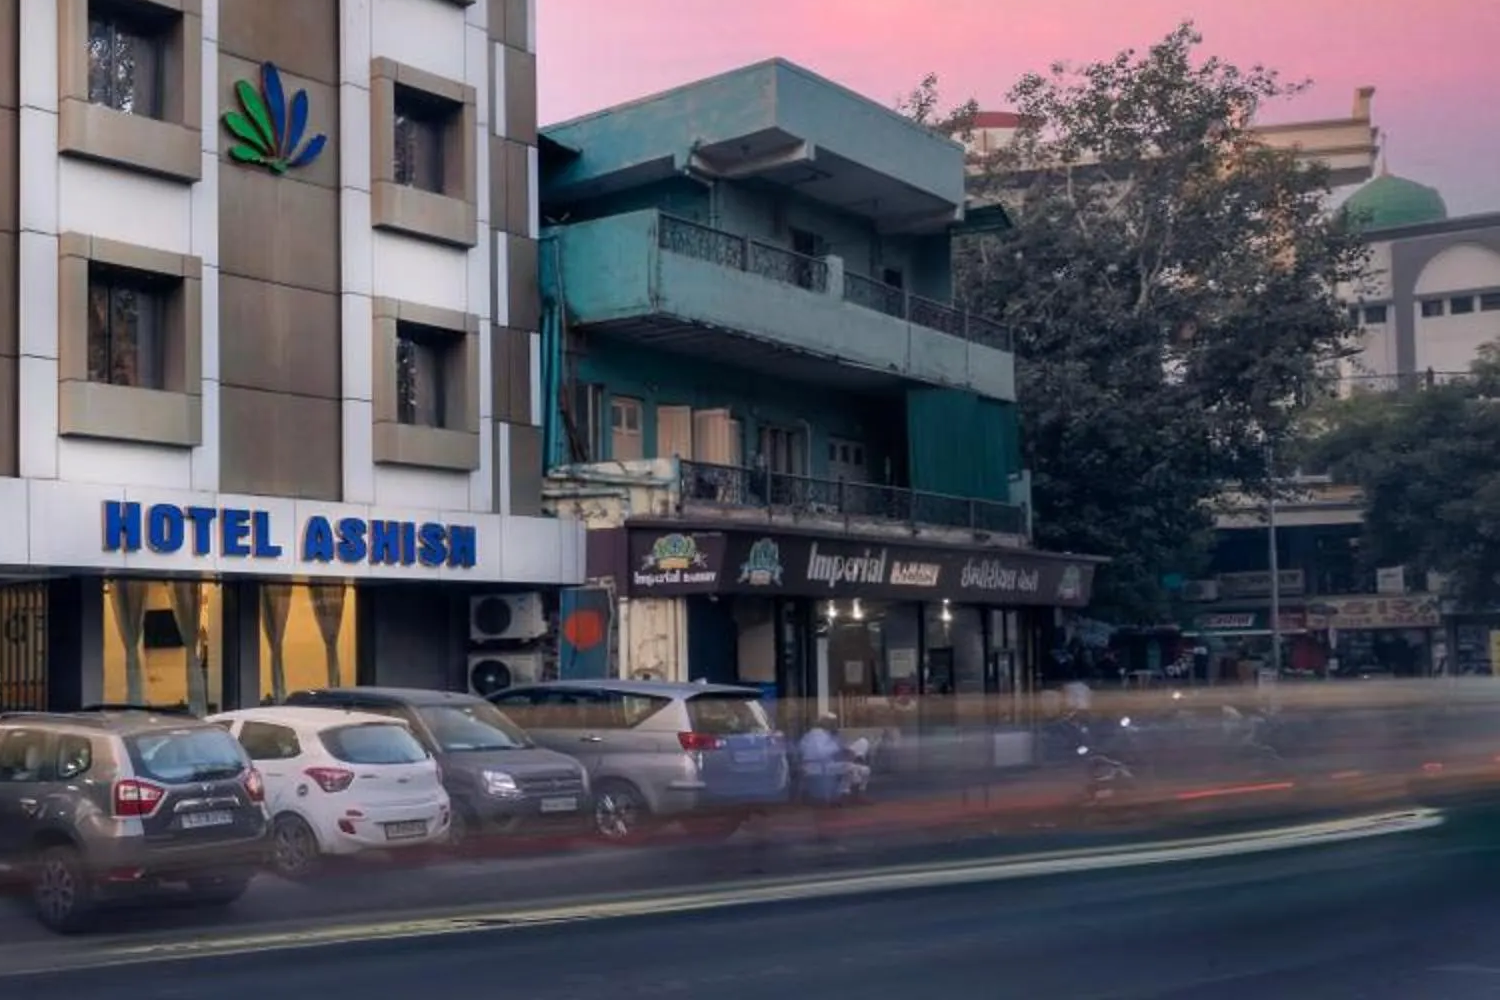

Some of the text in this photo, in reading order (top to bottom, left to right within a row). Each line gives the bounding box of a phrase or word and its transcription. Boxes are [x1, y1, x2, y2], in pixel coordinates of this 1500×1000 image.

[102, 500, 477, 569] HOTEL ASHISH
[807, 541, 888, 588] Imperial
